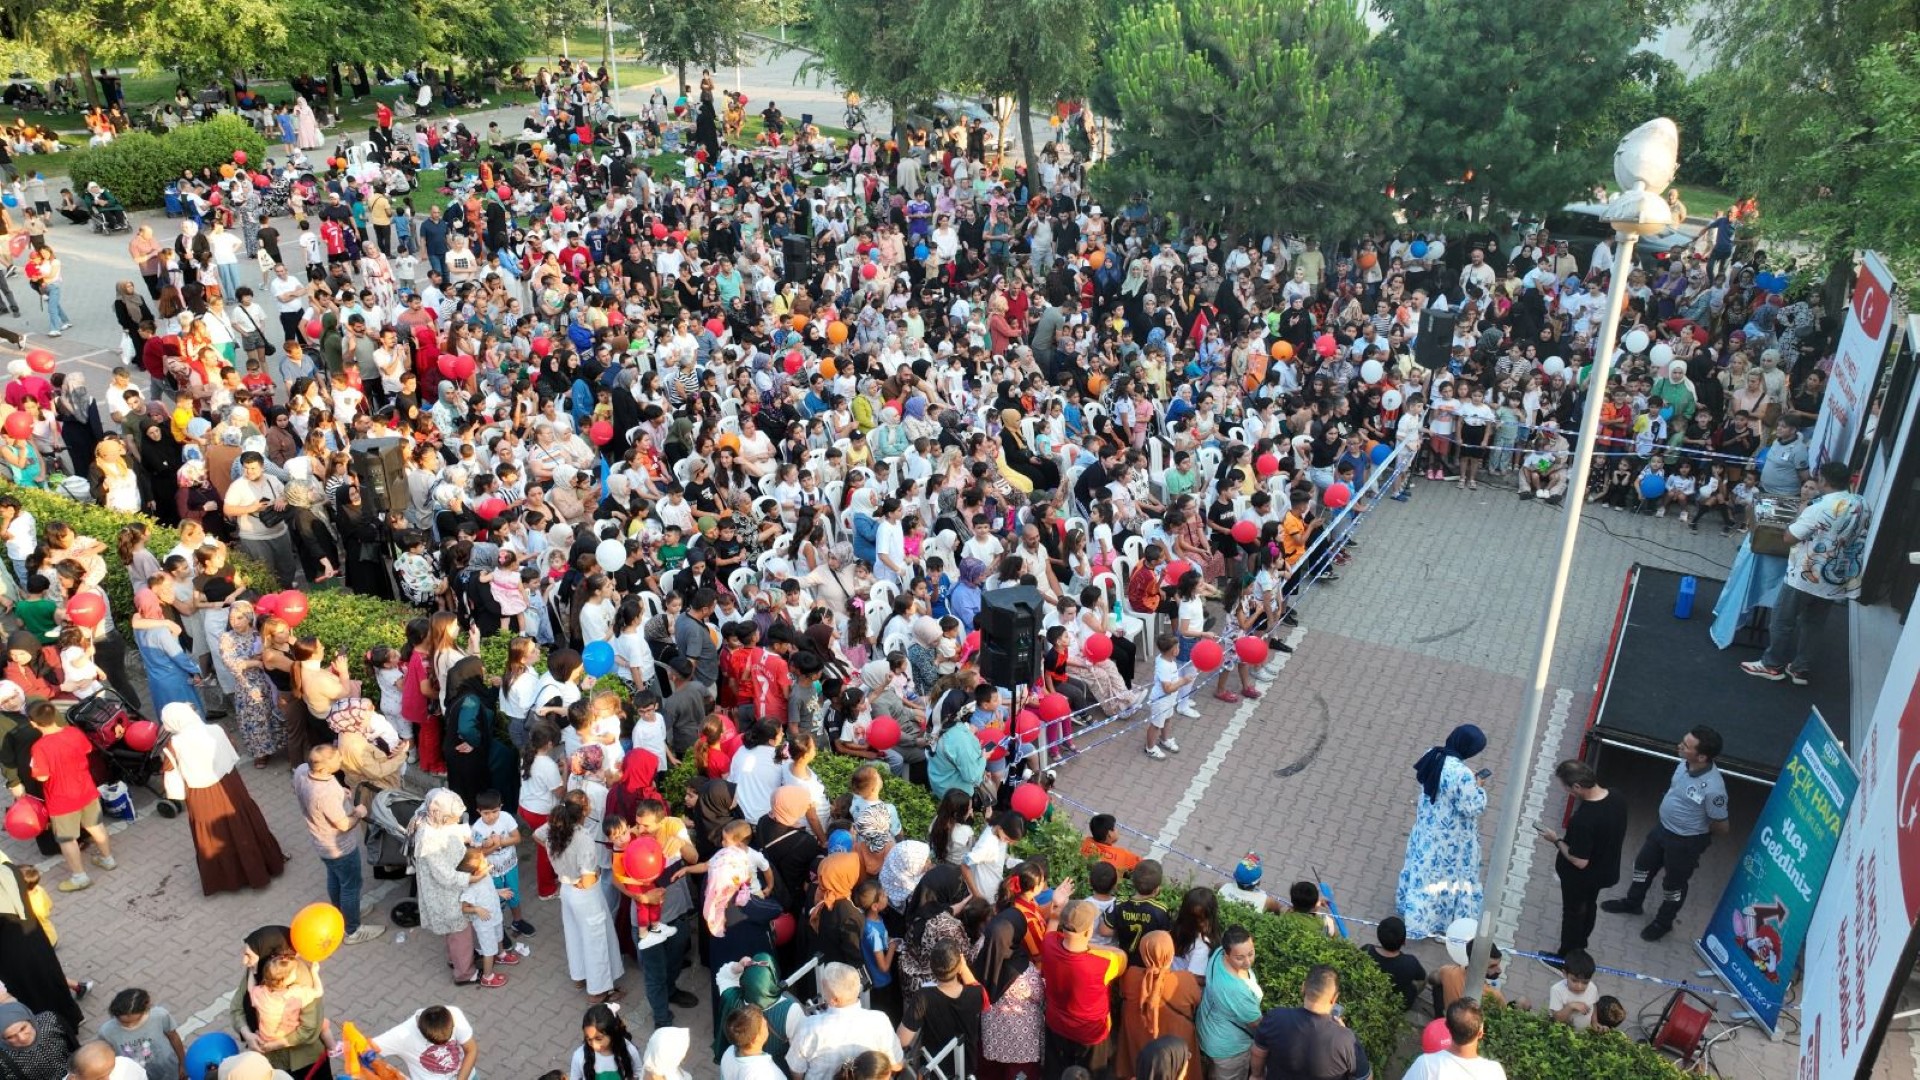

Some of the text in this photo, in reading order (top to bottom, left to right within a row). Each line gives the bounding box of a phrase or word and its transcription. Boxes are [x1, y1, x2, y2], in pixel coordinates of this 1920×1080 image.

[757, 675, 769, 701] 7
[1811, 788, 1841, 839] HAVA
[1782, 816, 1808, 862] Hoş
[1760, 826, 1813, 903] Geldiniz
[1130, 924, 1143, 953] 7
[1731, 961, 1748, 982] CAN
